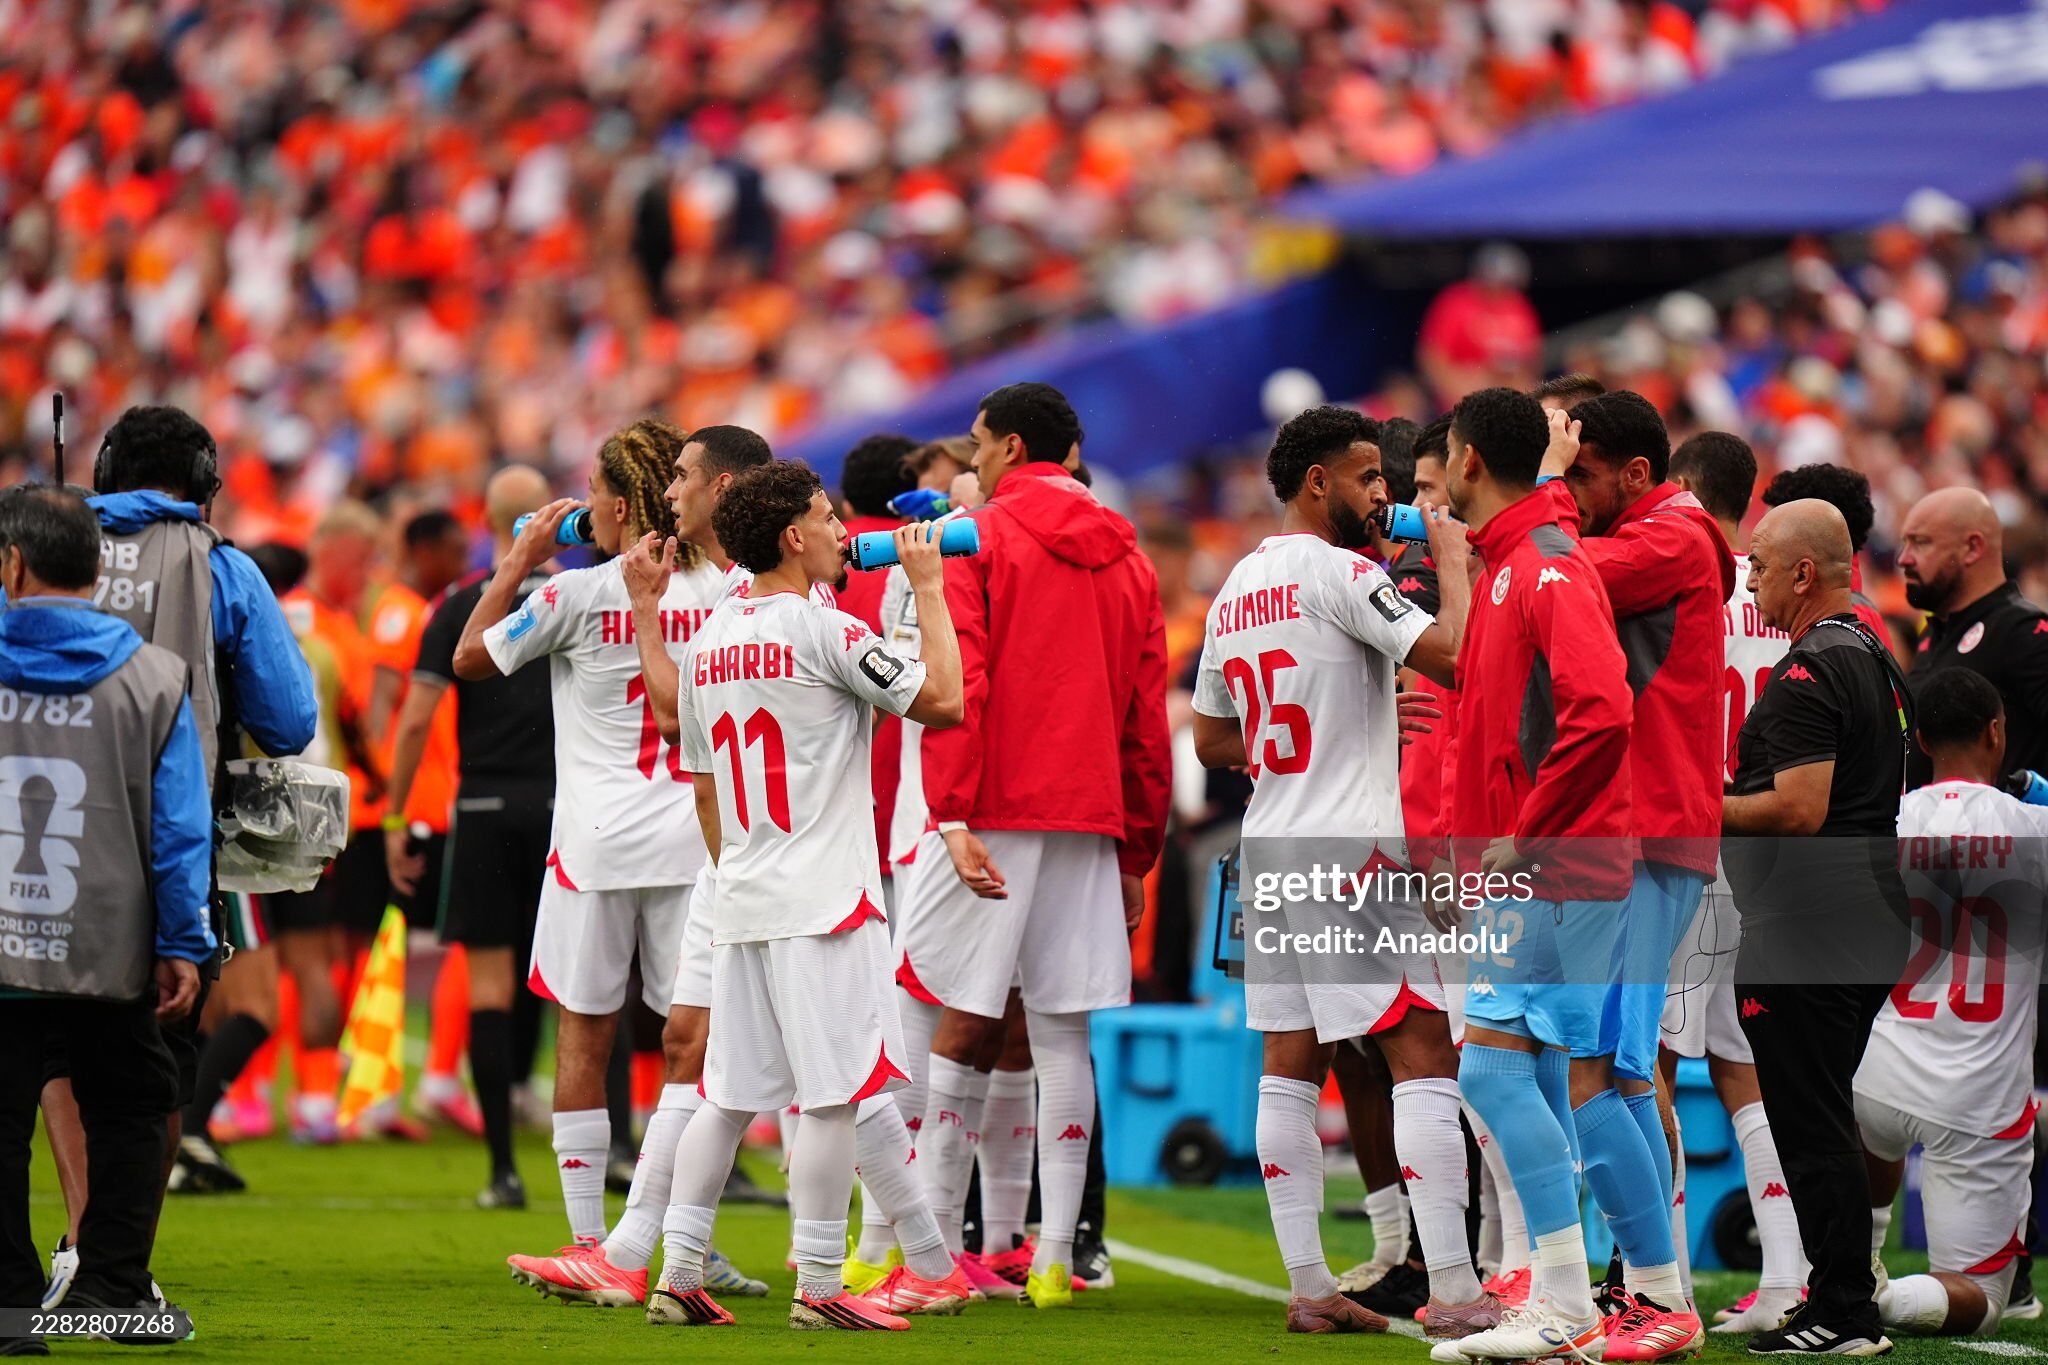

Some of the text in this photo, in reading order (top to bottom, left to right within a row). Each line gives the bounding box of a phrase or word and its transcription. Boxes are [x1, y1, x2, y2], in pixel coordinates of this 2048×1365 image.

[864, 542, 870, 552] 13
[1216, 583, 1300, 638] SLIMANE
[694, 642, 794, 687] GHARBI
[1222, 648, 1313, 781] 25
[711, 706, 791, 834] 11
[9, 880, 51, 900] FIFA
[0, 915, 73, 938] ORLD CUP
[0, 933, 70, 962] 026
[1890, 896, 2008, 1023] 20
